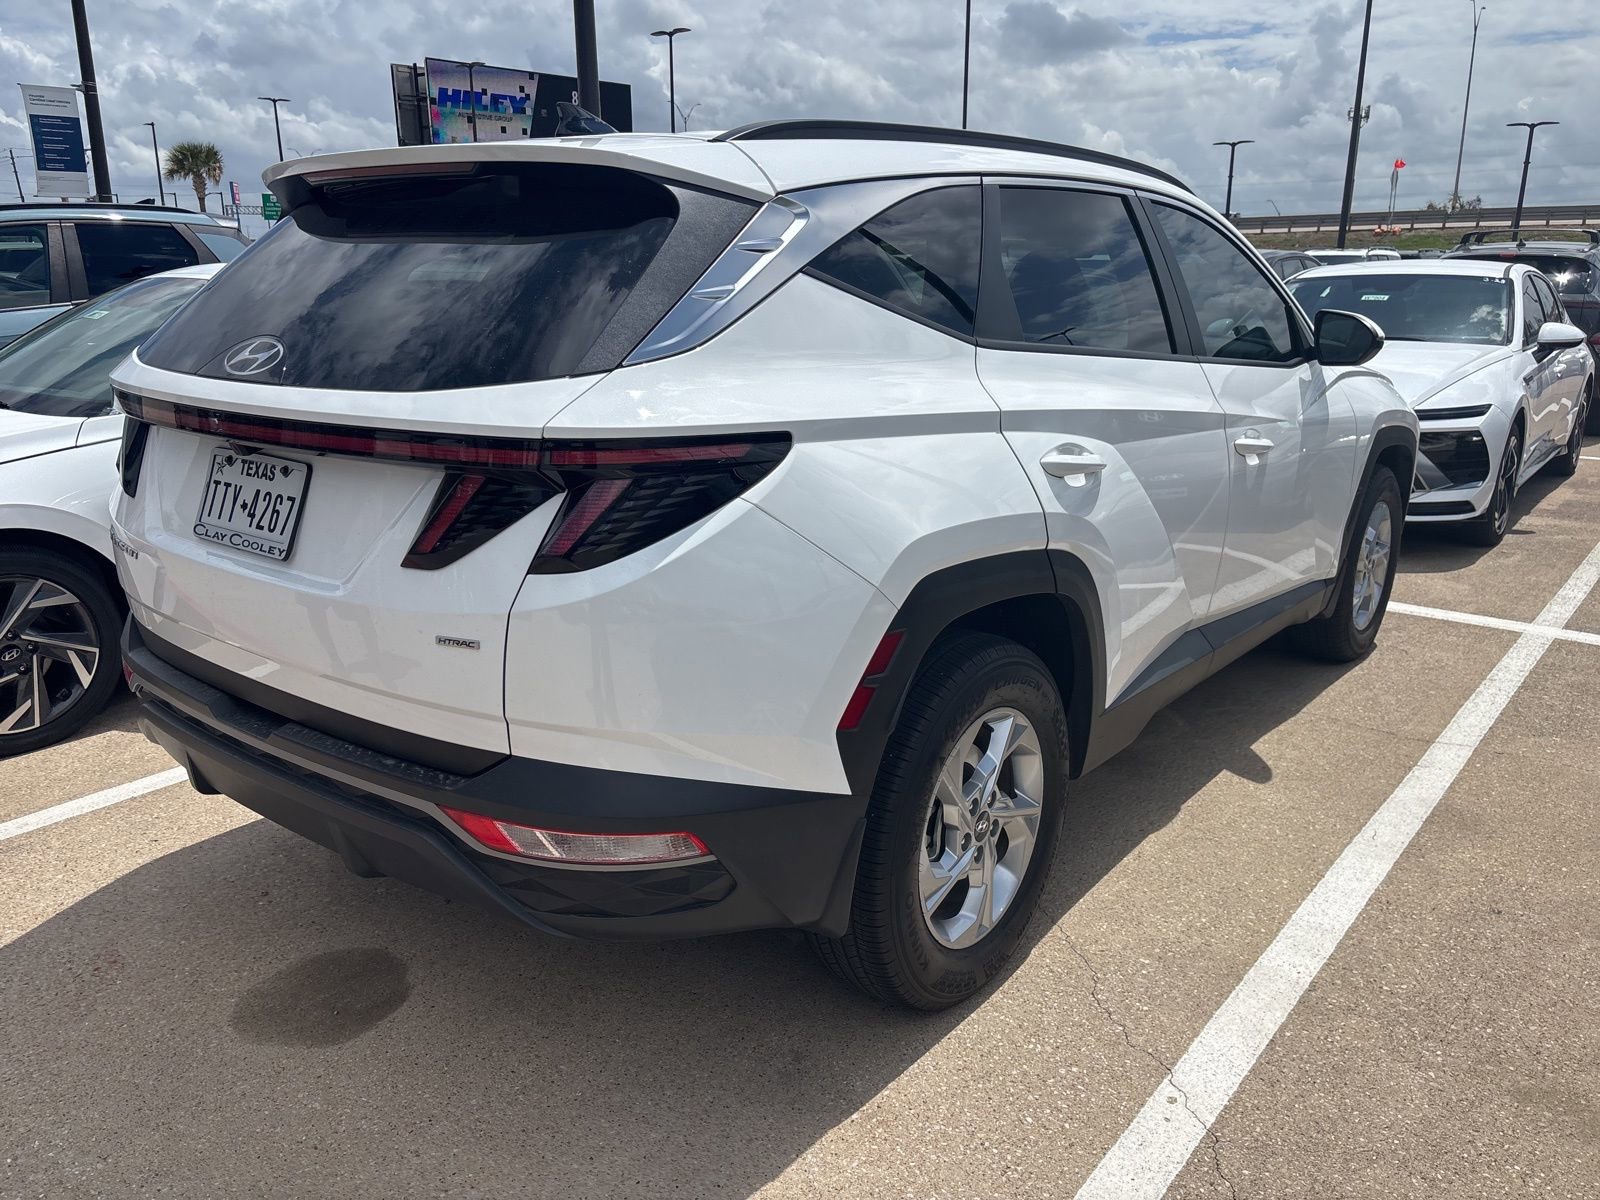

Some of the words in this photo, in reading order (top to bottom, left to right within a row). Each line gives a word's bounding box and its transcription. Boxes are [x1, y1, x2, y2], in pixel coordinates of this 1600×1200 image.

[437, 87, 527, 114] HILEY
[240, 459, 277, 482] TEXAS
[438, 637, 476, 648] HTRAC
